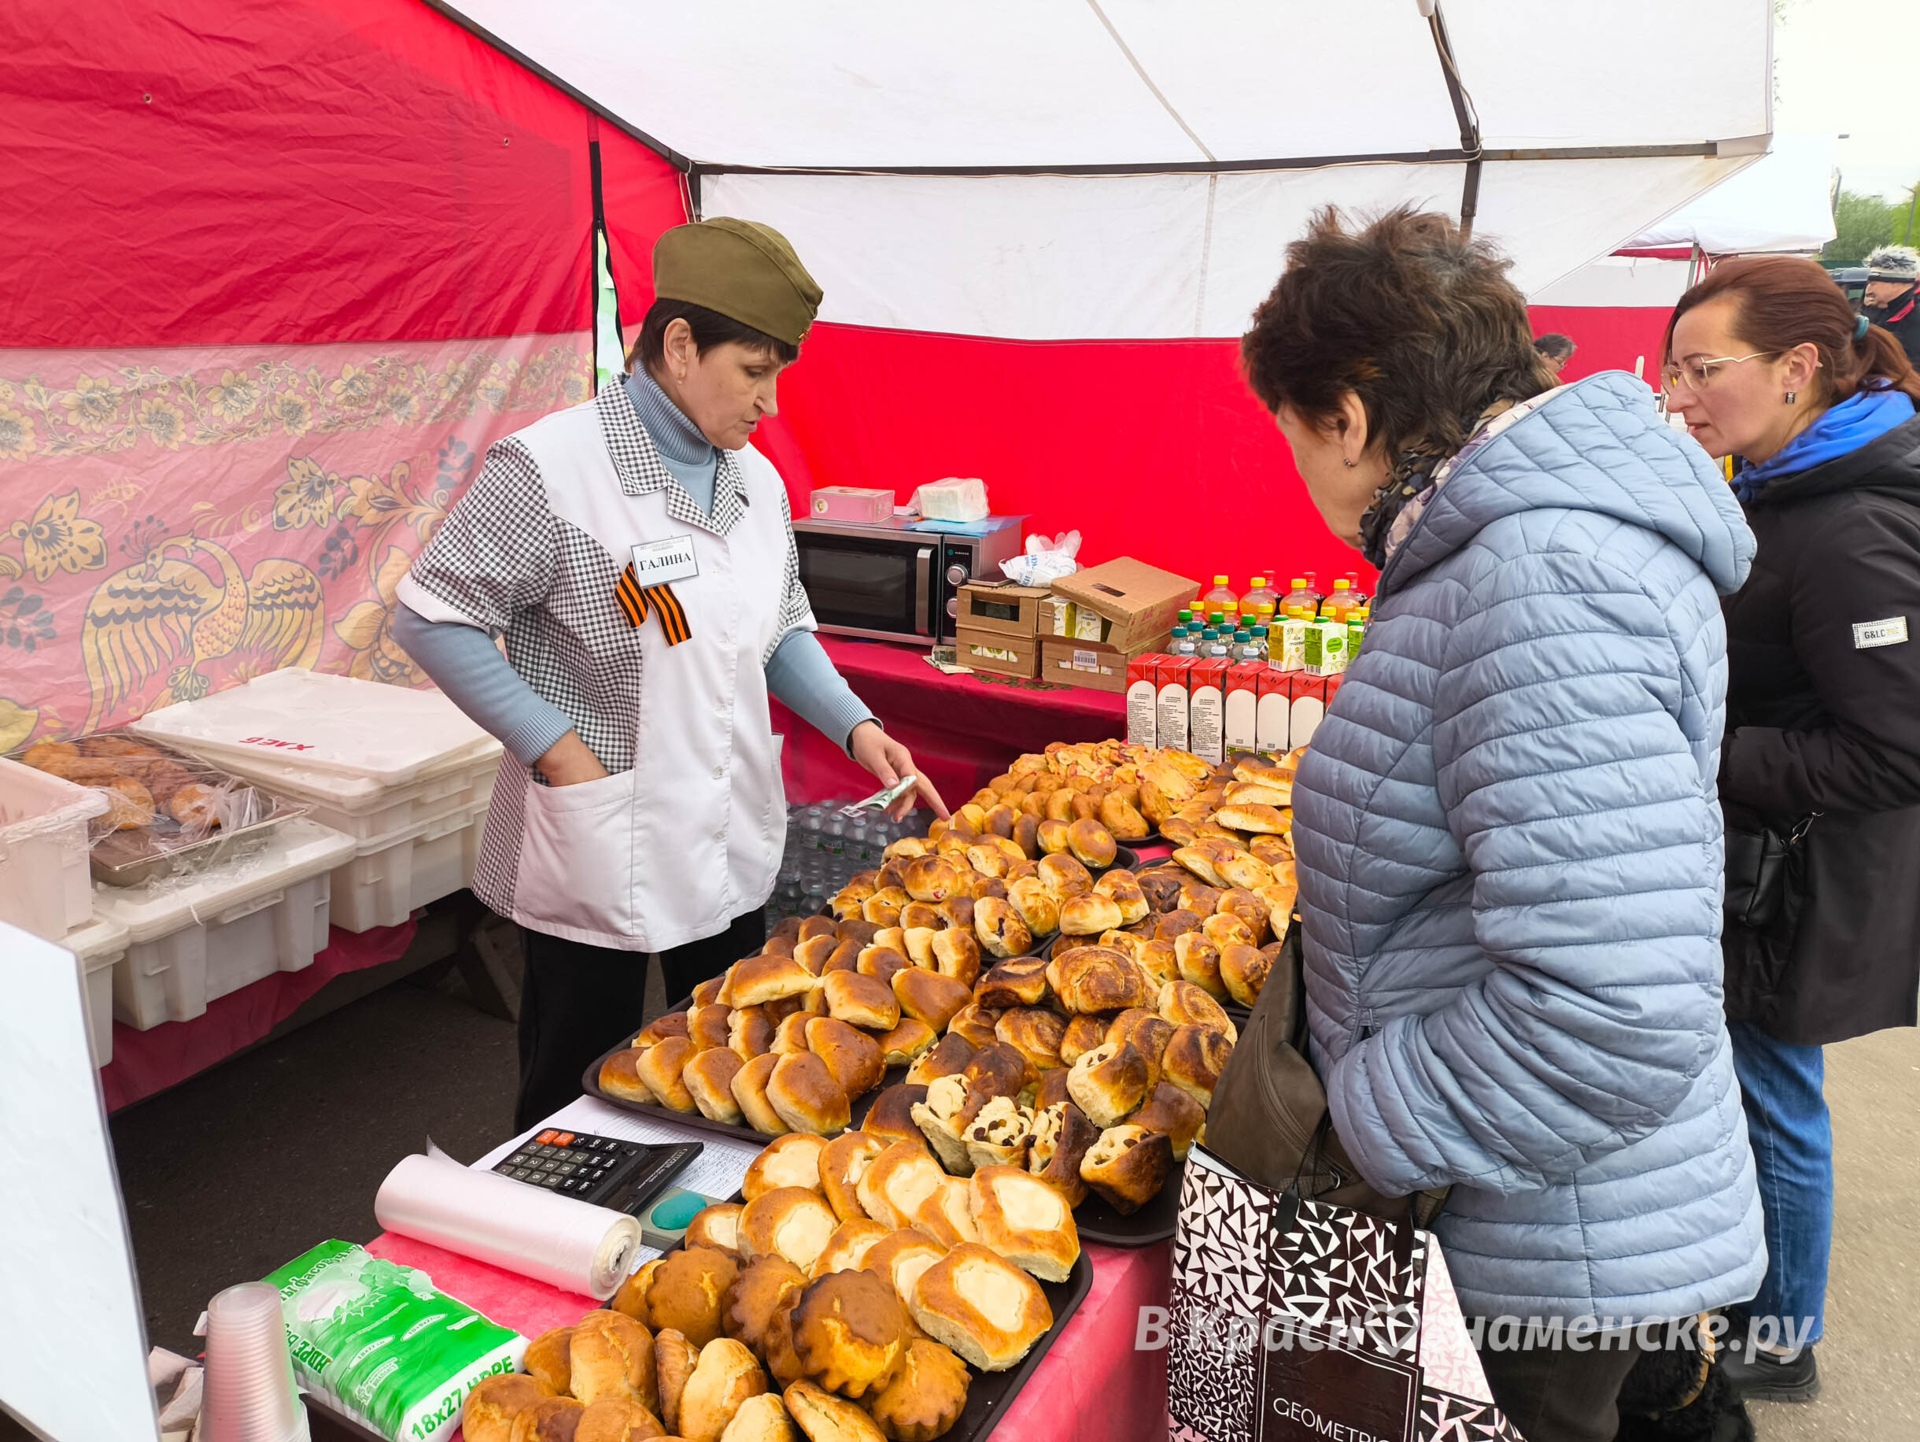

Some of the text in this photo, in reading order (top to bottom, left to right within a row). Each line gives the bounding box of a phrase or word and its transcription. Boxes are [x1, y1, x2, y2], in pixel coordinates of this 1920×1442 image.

[639, 552, 692, 571] ГАЛИНА
[1864, 628, 1887, 640] G&LC
[238, 736, 316, 752] ХЛЕБ
[291, 1340, 333, 1375] HDPE
[412, 1388, 463, 1440] 18x27
[1272, 1398, 1391, 1442] GEOMETR
